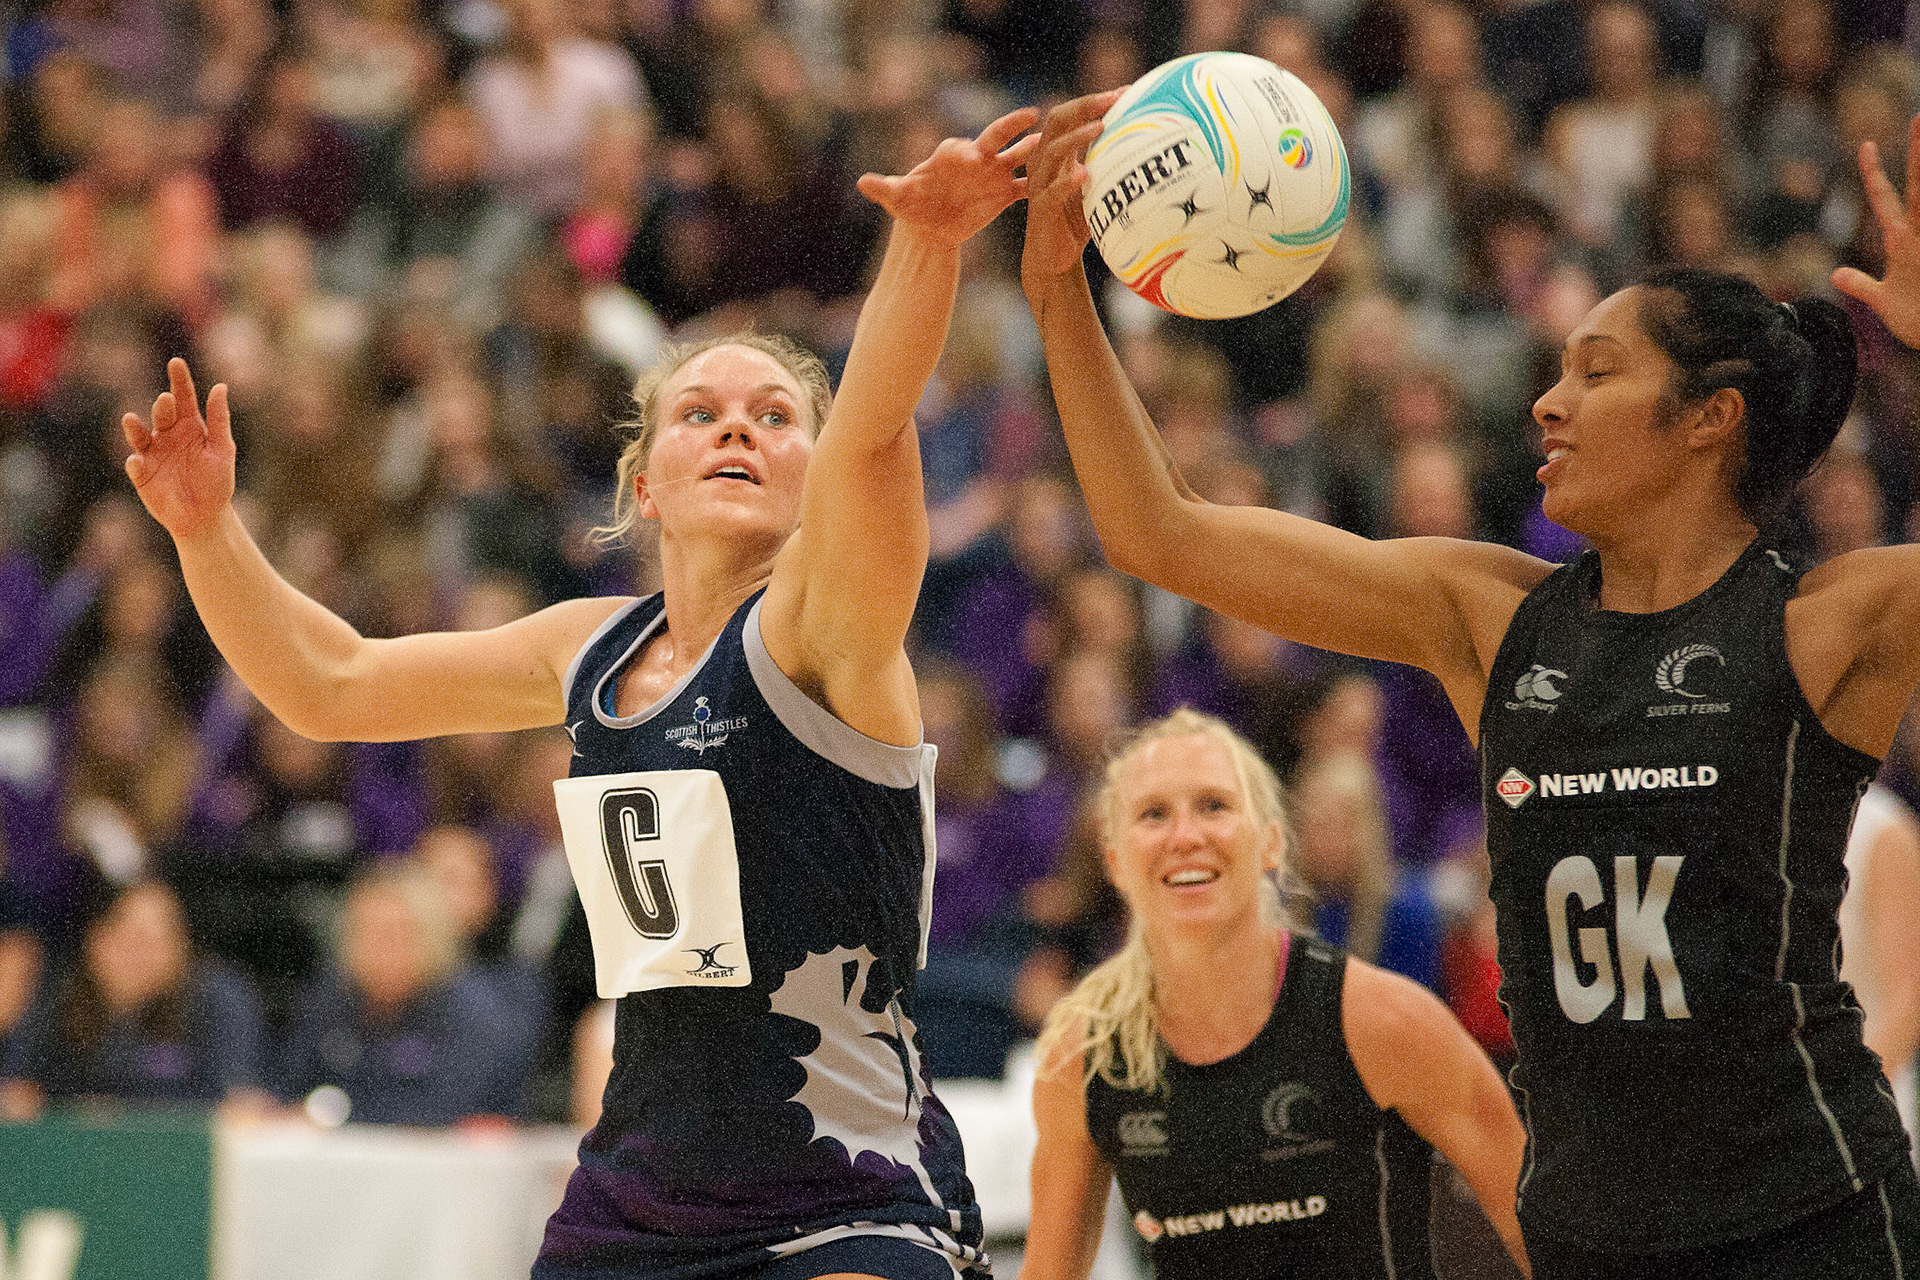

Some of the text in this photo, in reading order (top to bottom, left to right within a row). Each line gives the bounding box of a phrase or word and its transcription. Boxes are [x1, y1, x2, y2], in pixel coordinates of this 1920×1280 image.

[1089, 138, 1193, 248] ILBERT
[665, 717, 748, 740] SCOTTISH THISTLES
[1647, 704, 1689, 717] SILVER
[1540, 766, 1719, 798] NEW WORLD
[599, 787, 680, 940] C
[1545, 855, 1692, 1024] GK
[1164, 1195, 1328, 1238] NEW WORLD
